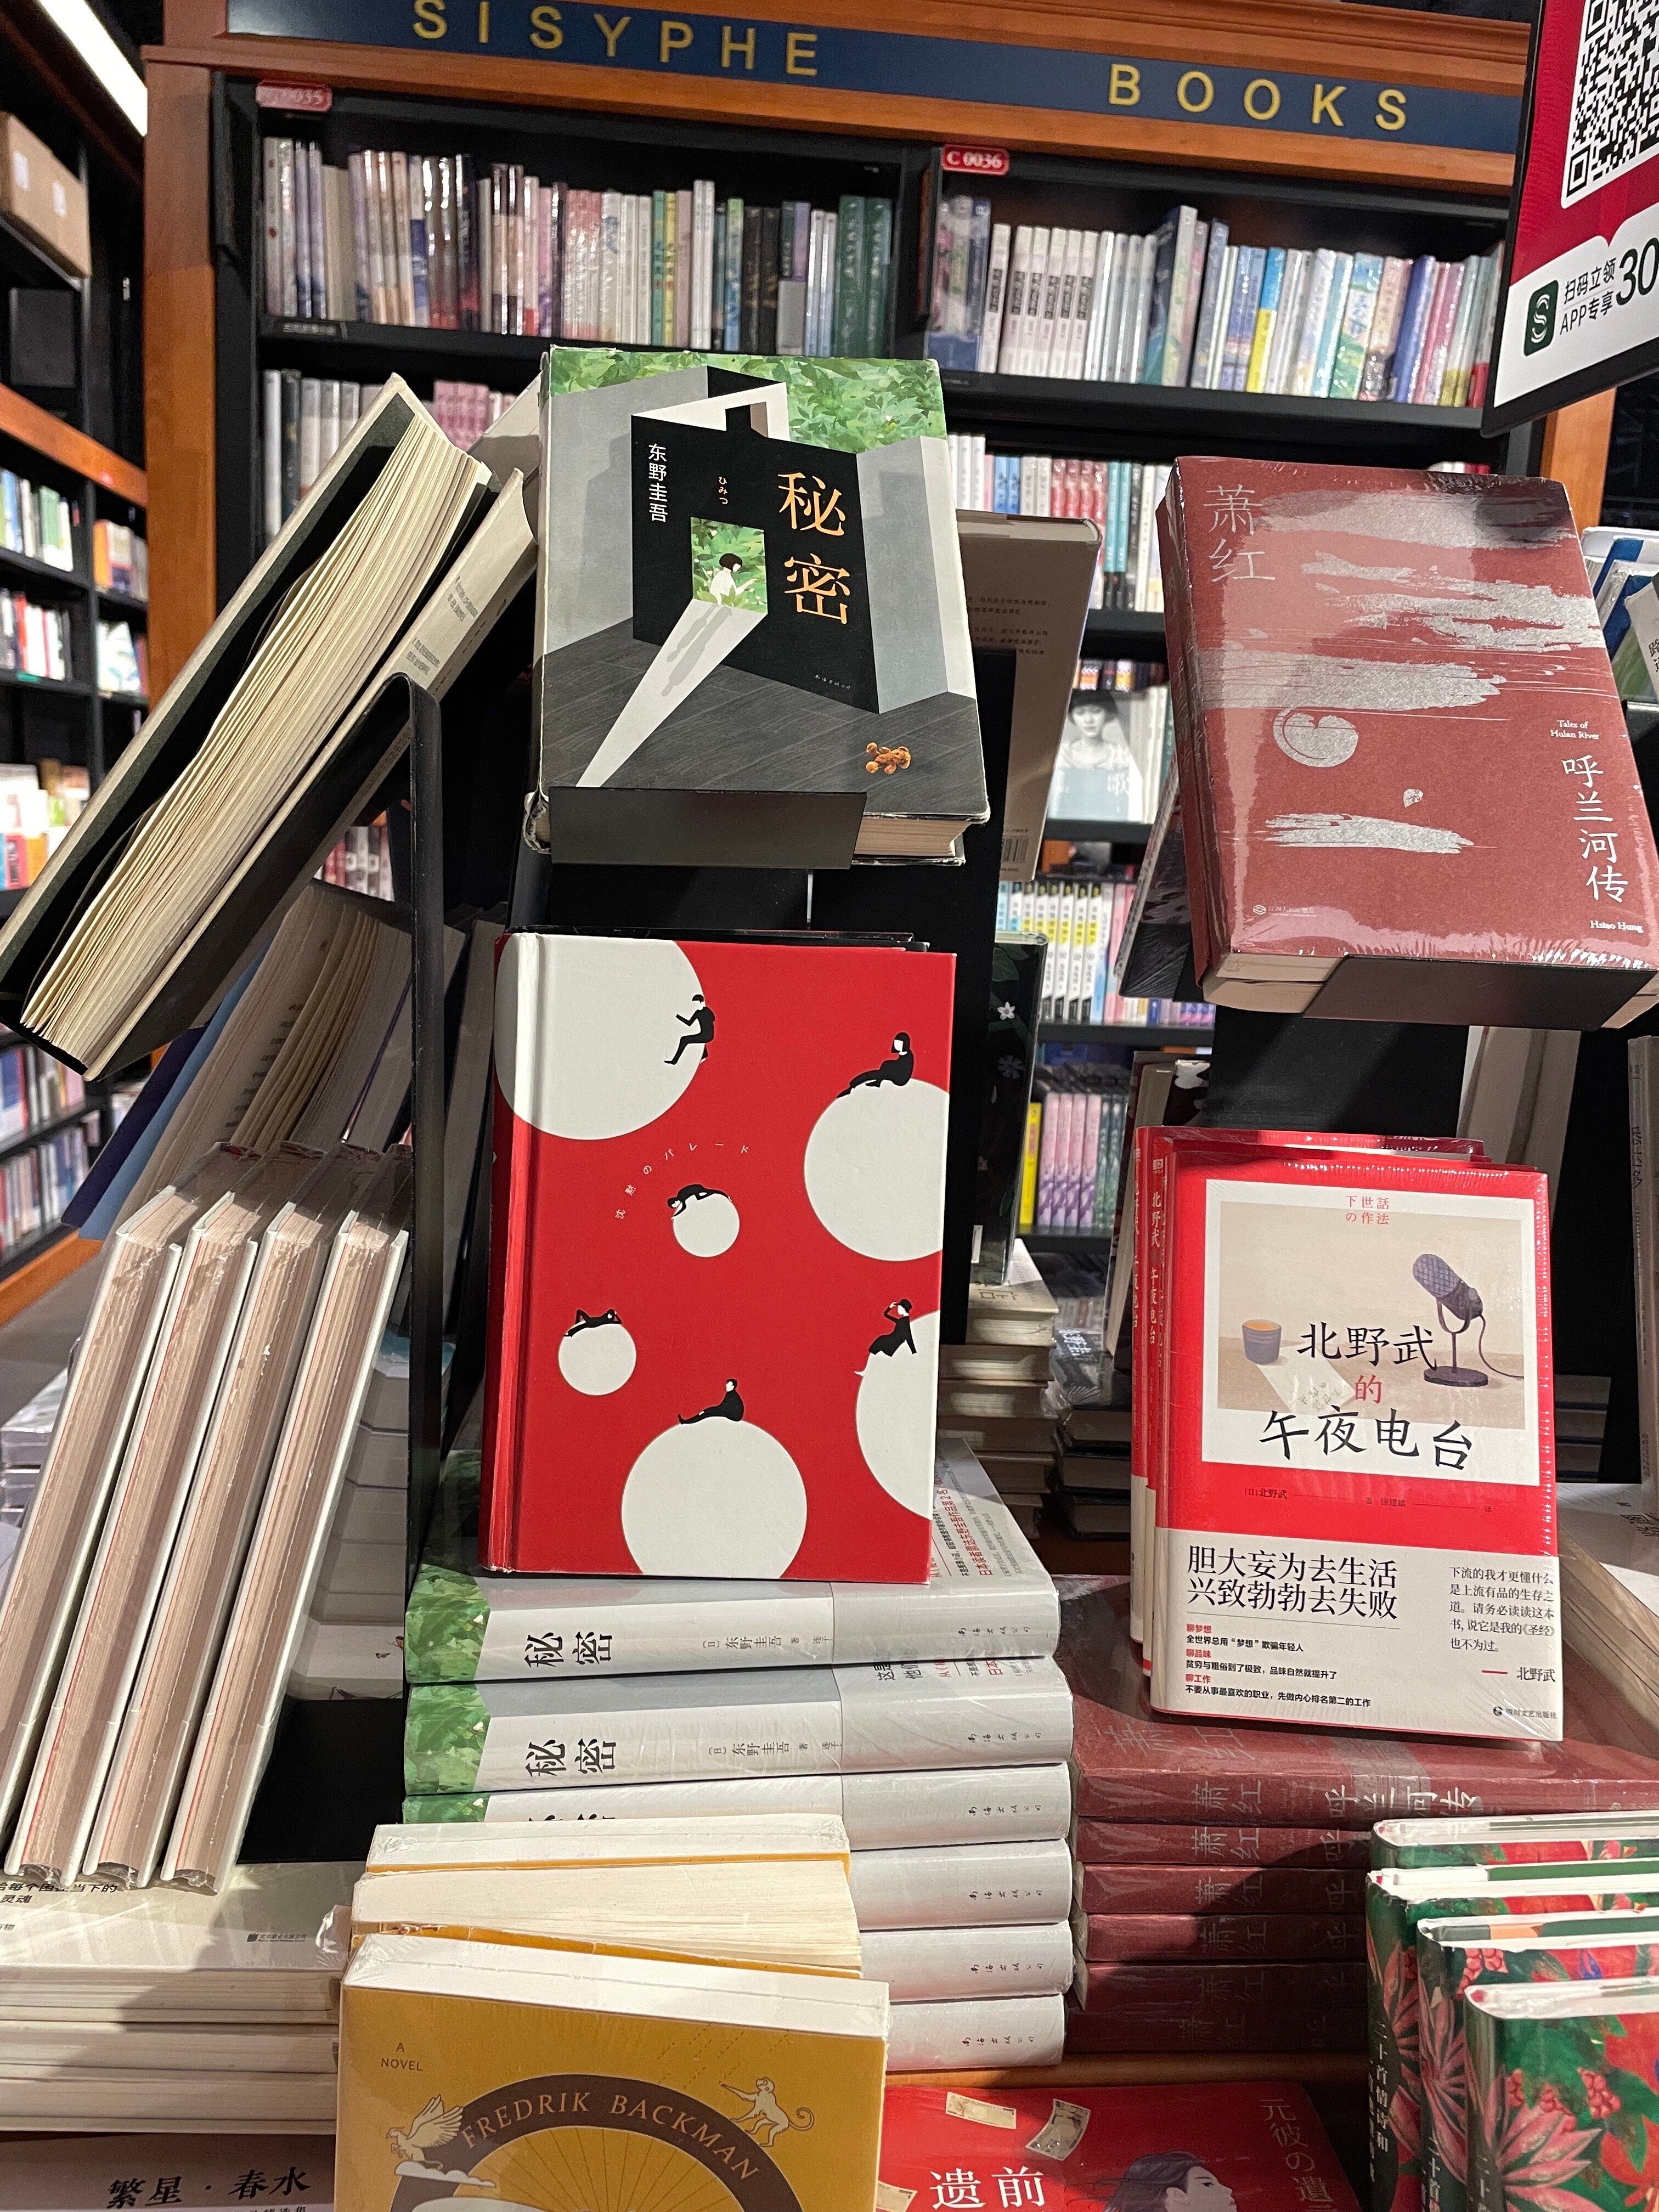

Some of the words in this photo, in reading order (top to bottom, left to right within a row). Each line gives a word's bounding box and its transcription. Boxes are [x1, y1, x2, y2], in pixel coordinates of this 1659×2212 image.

[413, 0, 819, 77] SISYPHE
[1109, 64, 1407, 131] BOOKS
[1564, 257, 1617, 305] 扫码立领
[1560, 290, 1614, 336] APP专享
[648, 443, 668, 523] 东野圭吾
[718, 476, 729, 505] ひみつ
[777, 470, 850, 625] 秘密
[1203, 483, 1276, 583] 萧红
[1550, 729, 1577, 739] Hulan
[1578, 731, 1600, 741] River
[1556, 719, 1578, 729] Tales
[1579, 721, 1589, 729] of
[1561, 754, 1629, 903] 呼兰河传
[1590, 919, 1616, 931] Hsiao
[1617, 921, 1645, 934] Hung
[1345, 1195, 1390, 1211] 下世話
[1345, 1211, 1390, 1226] の作法
[1296, 1321, 1437, 1374] 北野武
[1353, 1374, 1383, 1405] 的
[1259, 1405, 1473, 1472] 午夜电台
[1187, 1544, 1397, 1589] 胆大妄为去生活
[1449, 1566, 1554, 1584] 下流的我才更懂什么
[1187, 1575, 1398, 1620] 兴致勃勃去失败
[1449, 1583, 1554, 1602] 是上流有品的生存之
[1449, 1600, 1554, 1620] 道。请务必读读这本
[725, 1635, 781, 1650] 东野圭吾
[812, 1635, 834, 1644] 连子
[1186, 1623, 1212, 1634] 聊梦想
[523, 1630, 614, 1668] 秘密
[1186, 1649, 1211, 1658] 聊品味
[1450, 1637, 1499, 1653] 也不为过。
[1185, 1674, 1211, 1684] 聊工作
[1516, 1667, 1556, 1683] 北野武
[526, 1737, 617, 1778] 秘密
[732, 1741, 789, 1757] 东野圭吾
[821, 1741, 842, 1751] 连子
[1192, 1780, 1261, 1814] 萧红
[1191, 1826, 1260, 1860] 萧红
[0, 1882, 118, 1893] 每个困当下的
[396, 2042, 405, 2053] A
[380, 2056, 423, 2072] NOVEL
[462, 2091, 591, 2150] FREDRIK
[610, 2095, 762, 2181] BACKMAN
[1259, 2098, 1338, 2212] 元彼の遺
